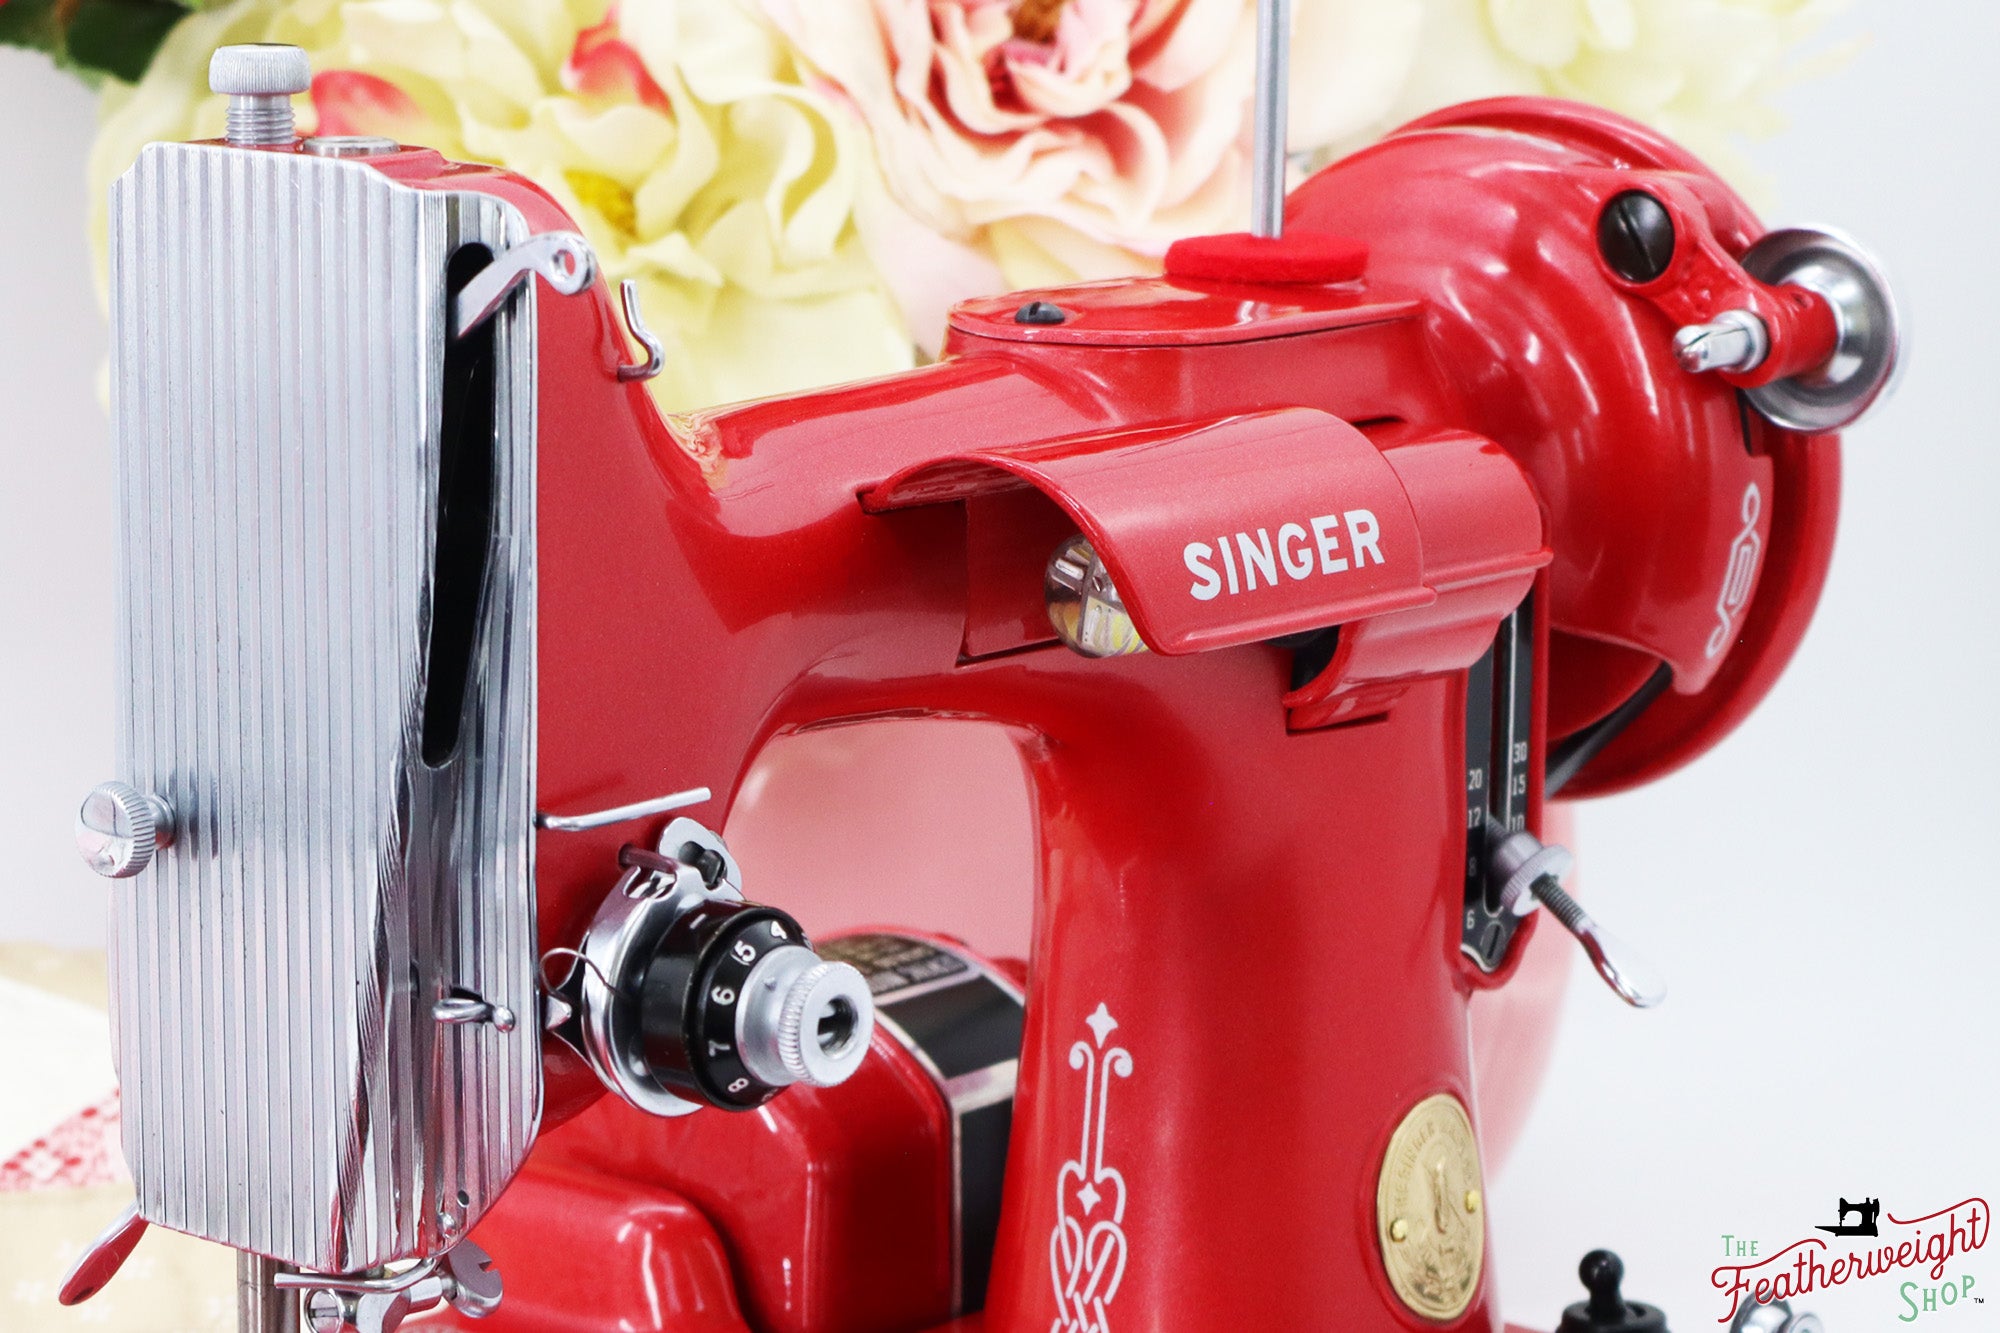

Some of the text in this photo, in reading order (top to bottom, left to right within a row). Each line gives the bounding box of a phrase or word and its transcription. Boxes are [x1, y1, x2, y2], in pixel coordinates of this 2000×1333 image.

[1183, 509, 1385, 601] SINGER
[1513, 741, 1527, 763] 30
[1468, 768, 1482, 790] 20
[1512, 776, 1526, 796] 15
[1468, 807, 1481, 829] 12
[770, 920, 788, 940] 4
[1466, 909, 1475, 930] 6
[734, 940, 757, 963] 5
[711, 986, 735, 1006] 6
[708, 1039, 730, 1057] 7
[727, 1077, 749, 1093] 8
